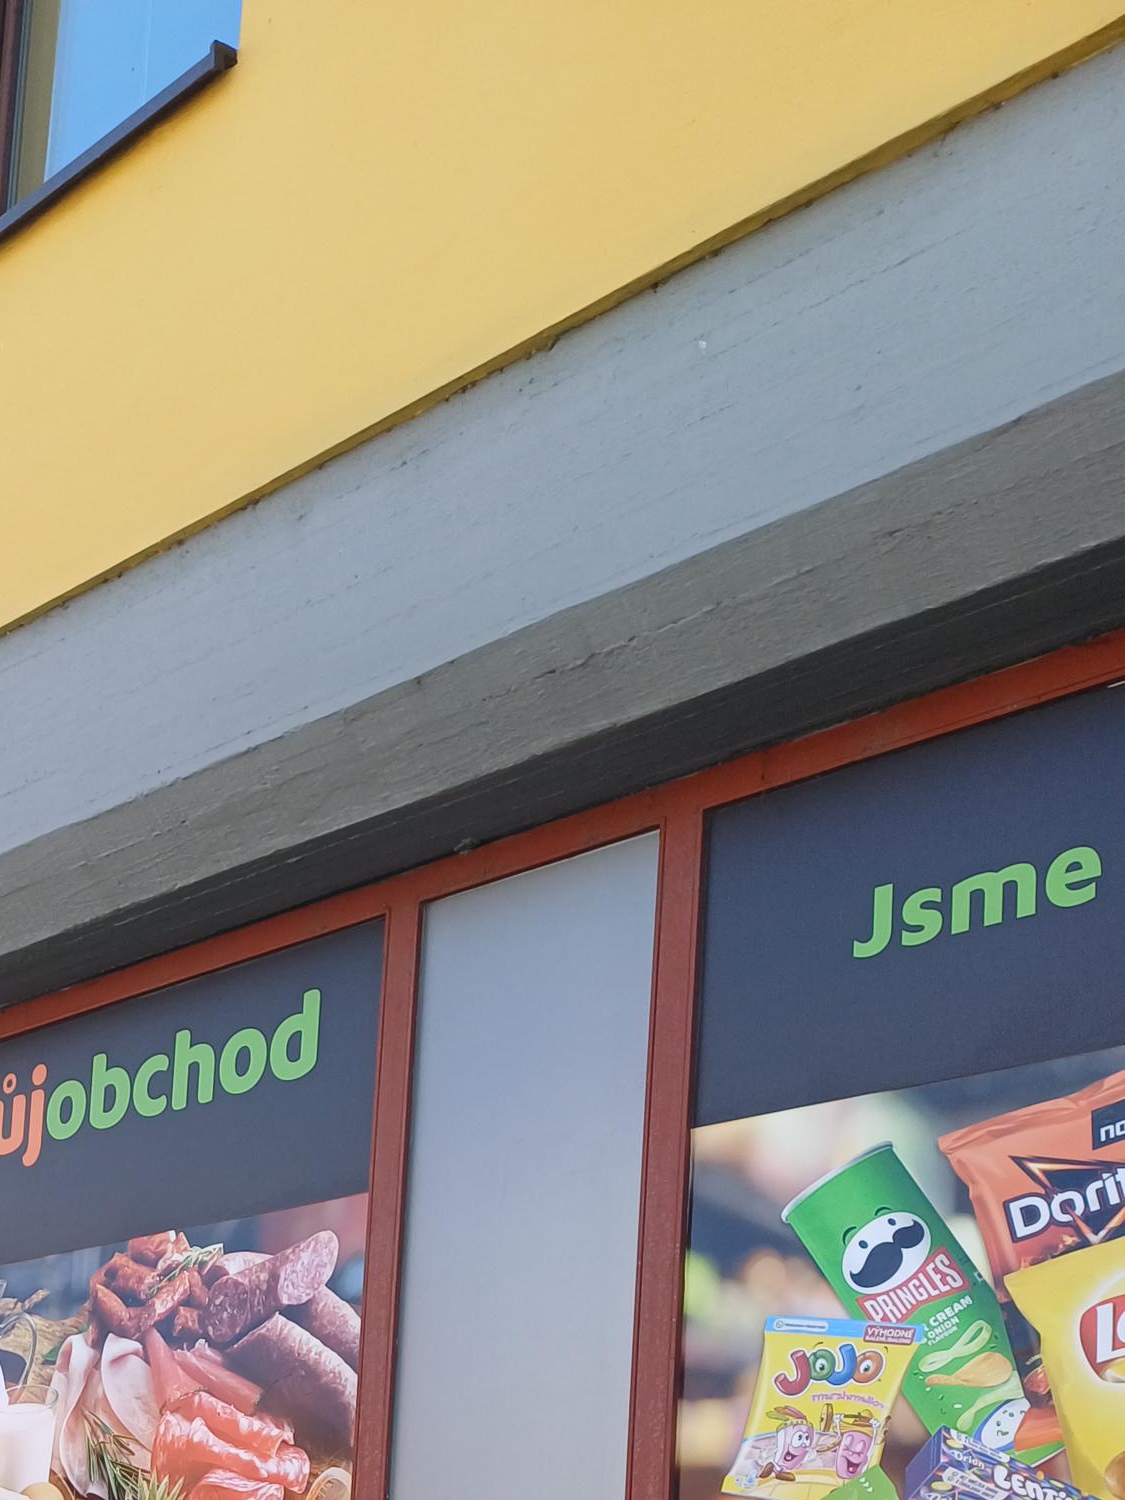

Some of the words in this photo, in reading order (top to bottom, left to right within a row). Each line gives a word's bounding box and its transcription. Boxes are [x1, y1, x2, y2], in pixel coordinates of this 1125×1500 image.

[852, 845, 1103, 960] Jsme
[863, 1253, 965, 1324] PRINGLES
[929, 1295, 973, 1327] CREAM
[927, 1316, 960, 1339] ONION
[950, 1450, 985, 1470] Orion
